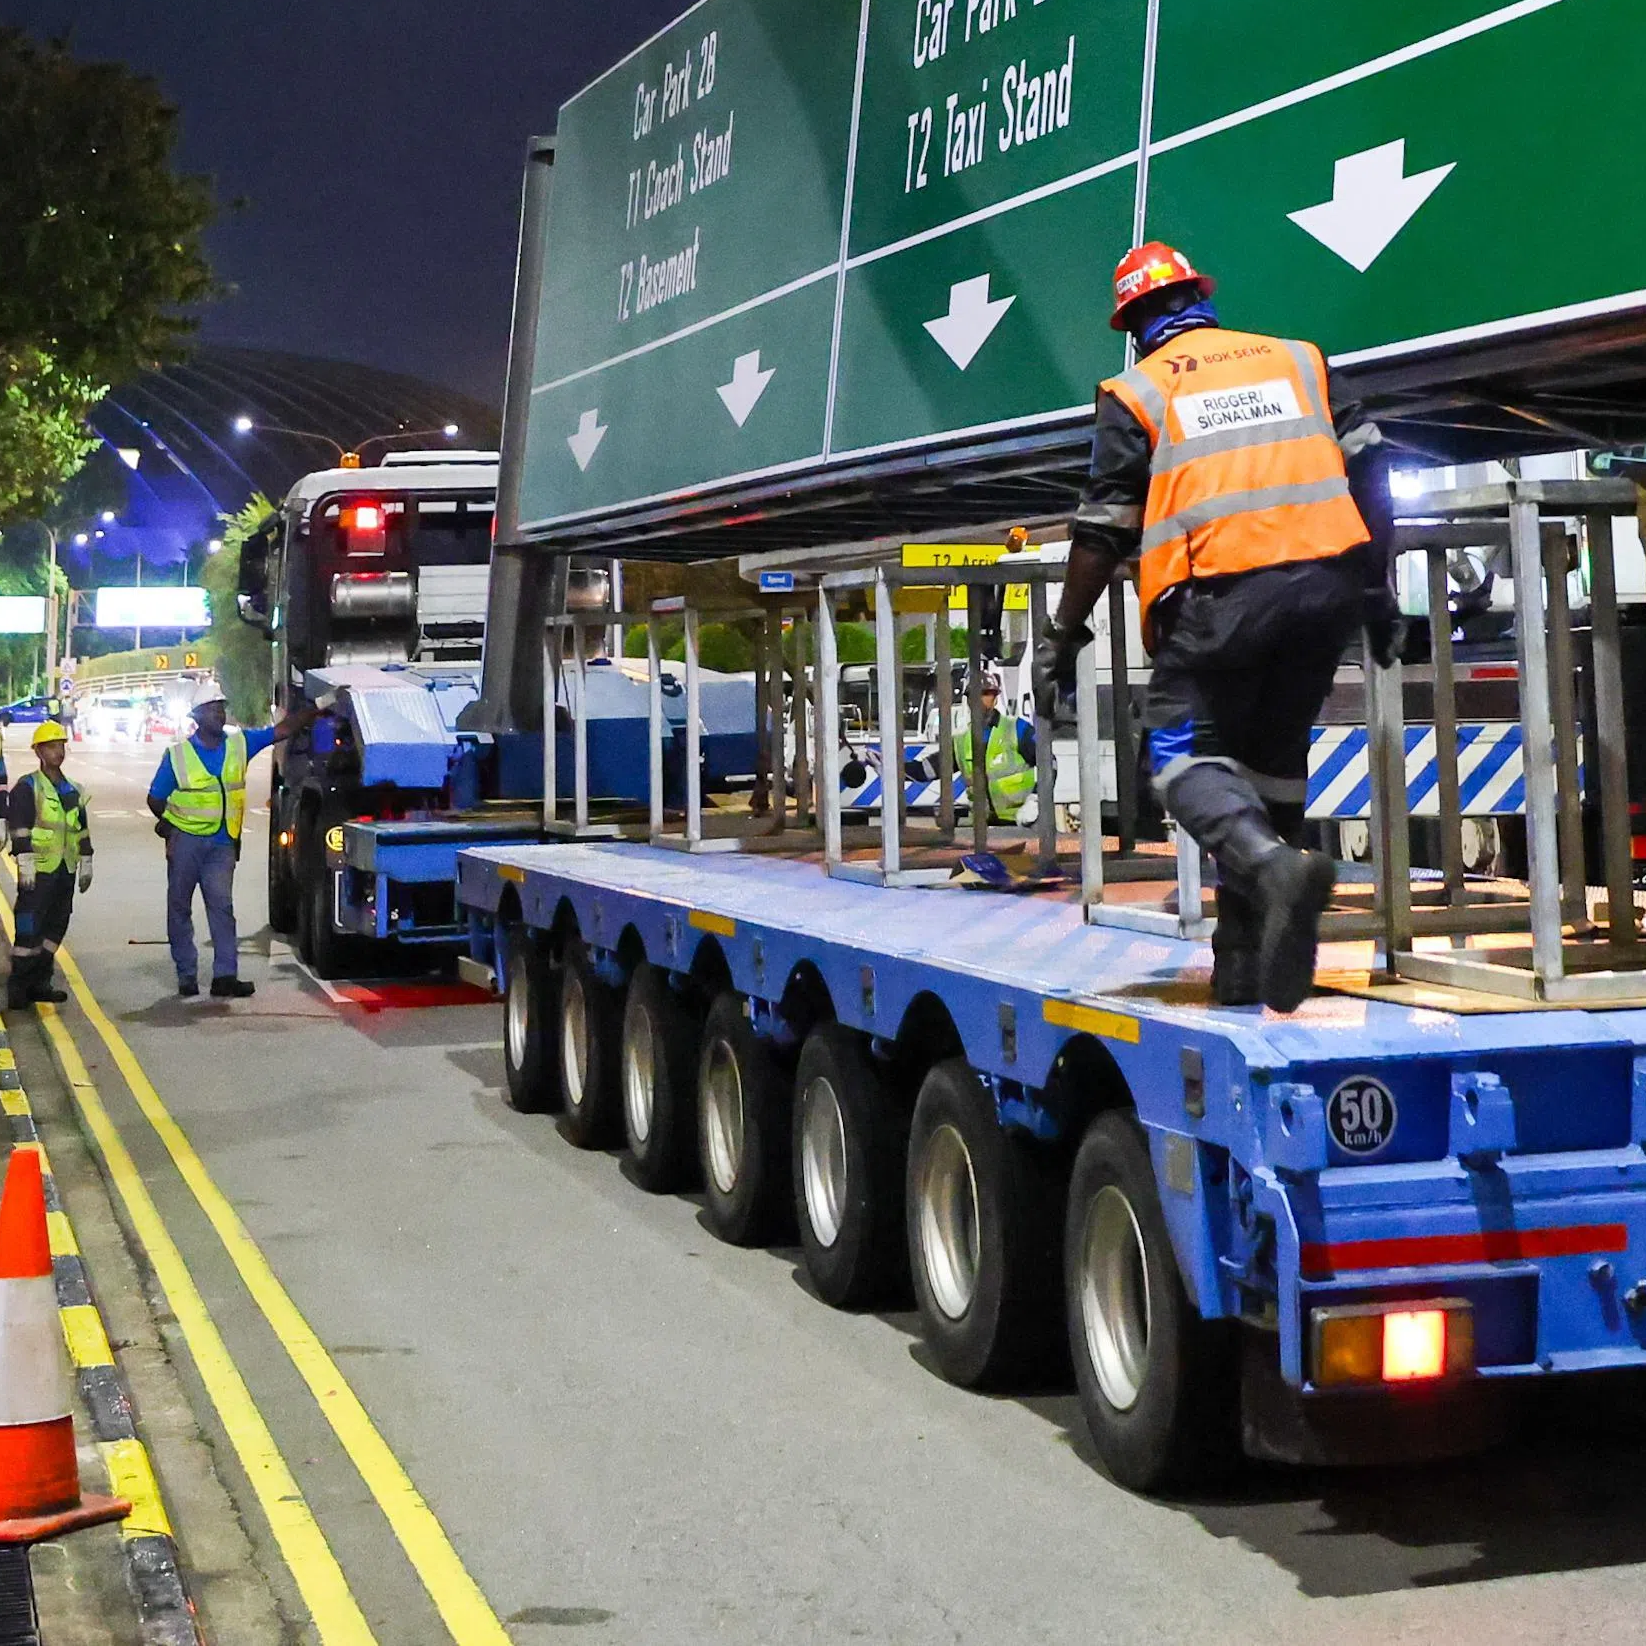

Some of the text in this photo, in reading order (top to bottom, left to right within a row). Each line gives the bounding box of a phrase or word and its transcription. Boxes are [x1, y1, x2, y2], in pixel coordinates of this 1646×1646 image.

[633, 31, 718, 141] Car Park 2B
[904, 35, 1075, 194] T2 Taxi Stand
[626, 110, 734, 231] T1 Coach Stand
[618, 226, 700, 322] T2 Basement
[1203, 345, 1271, 364] BOK SENG
[1198, 402, 1283, 429] SIGNALMAN
[1339, 1086, 1384, 1132] 50
[1344, 1129, 1382, 1146] km/h
